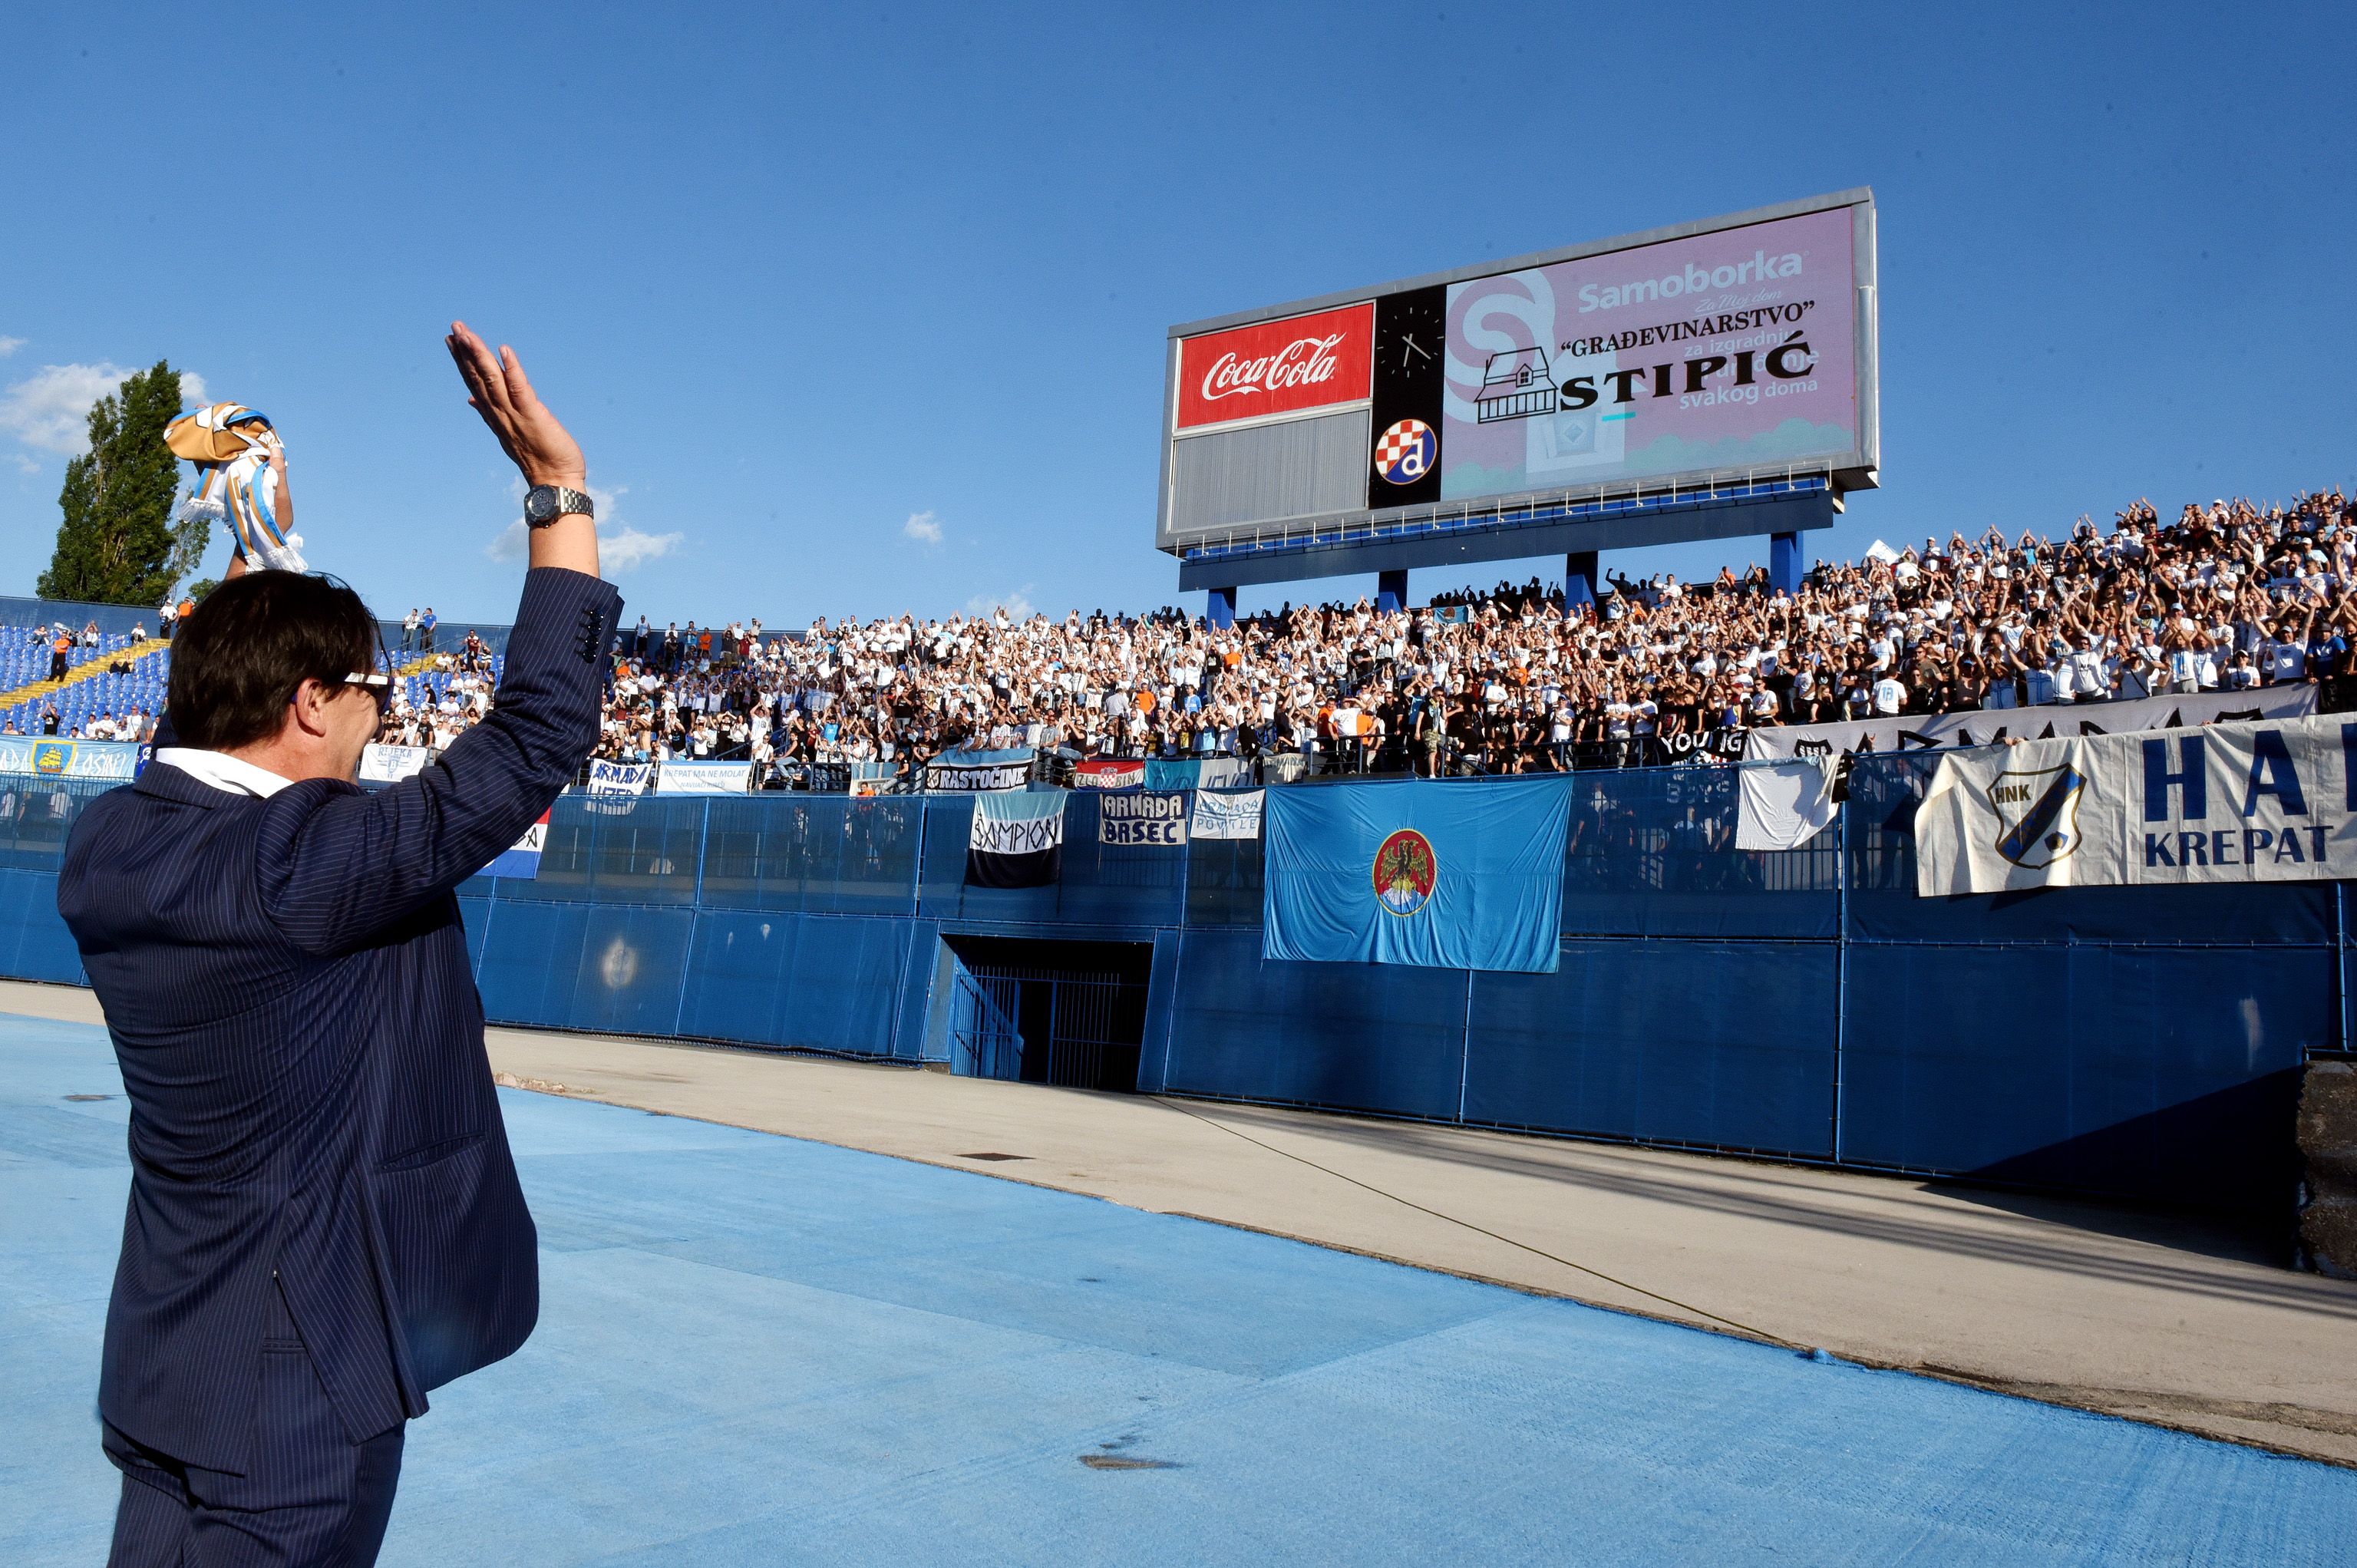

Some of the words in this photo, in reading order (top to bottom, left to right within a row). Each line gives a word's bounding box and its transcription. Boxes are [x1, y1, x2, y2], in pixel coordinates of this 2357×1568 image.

[1578, 250, 1802, 313] Samoborka
[1684, 340, 1703, 358] za
[1202, 332, 1347, 400] Coca-Cola
[1560, 330, 1815, 411] STIPIĆ
[1679, 384, 1759, 409] svakog
[1764, 381, 1817, 398] doma
[378, 747, 412, 759] RIJEKA
[719, 769, 746, 777] MOLAT
[939, 766, 1028, 789] RASTOČINE
[1104, 794, 1183, 818] ARMADA
[1995, 784, 2032, 804] HNK
[1104, 817, 1177, 843] BRSEČ
[2145, 825, 2334, 867] KREPAT
